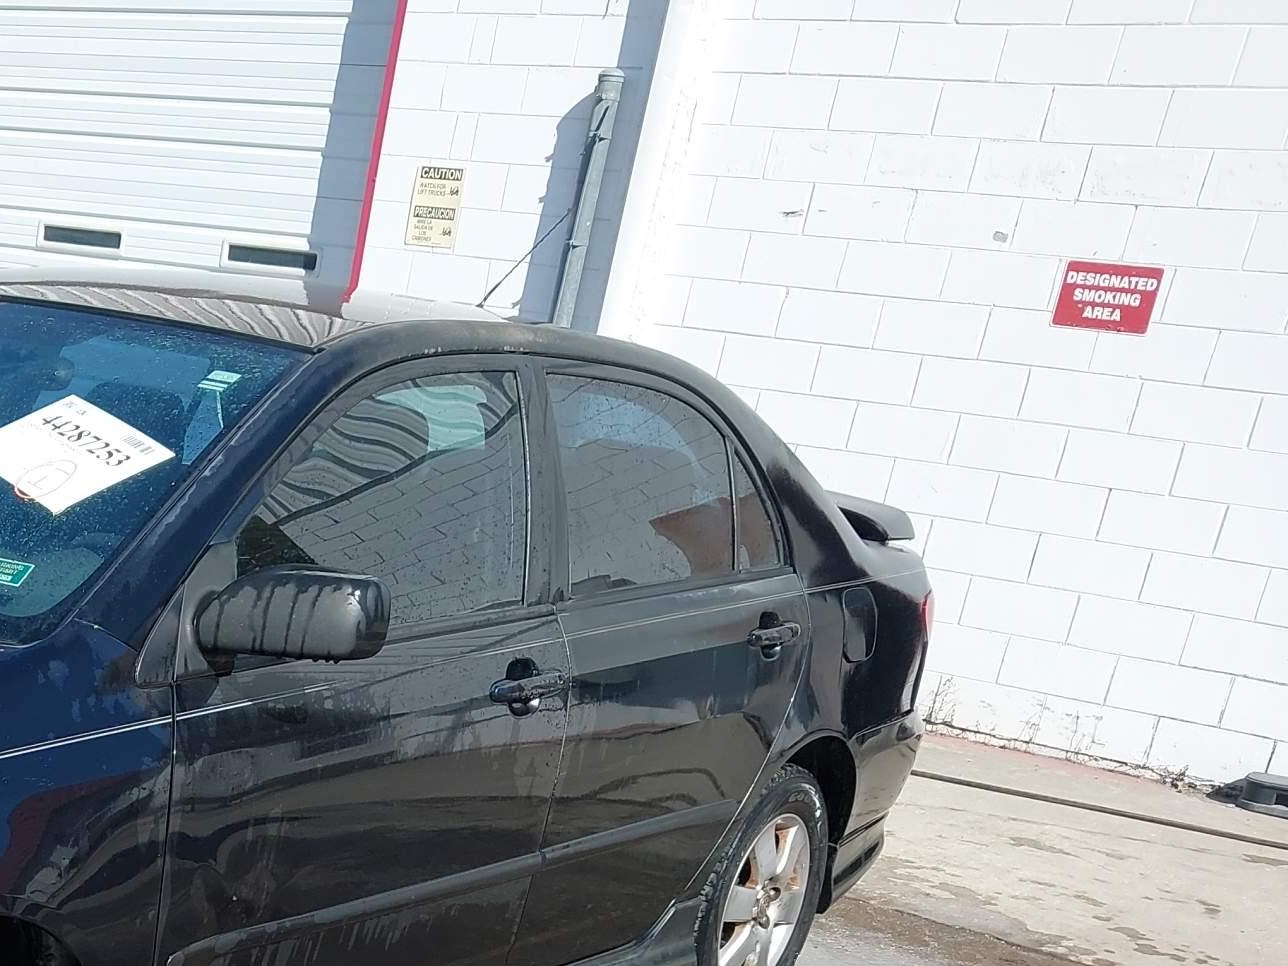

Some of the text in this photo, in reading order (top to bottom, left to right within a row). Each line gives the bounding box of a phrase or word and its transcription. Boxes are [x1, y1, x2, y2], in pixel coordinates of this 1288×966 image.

[422, 167, 462, 181] CAUTION
[1066, 271, 1158, 291] DESIGNATED
[1073, 288, 1142, 307] SMOKING
[1082, 306, 1121, 322] AREA
[41, 415, 132, 467] 44287253
